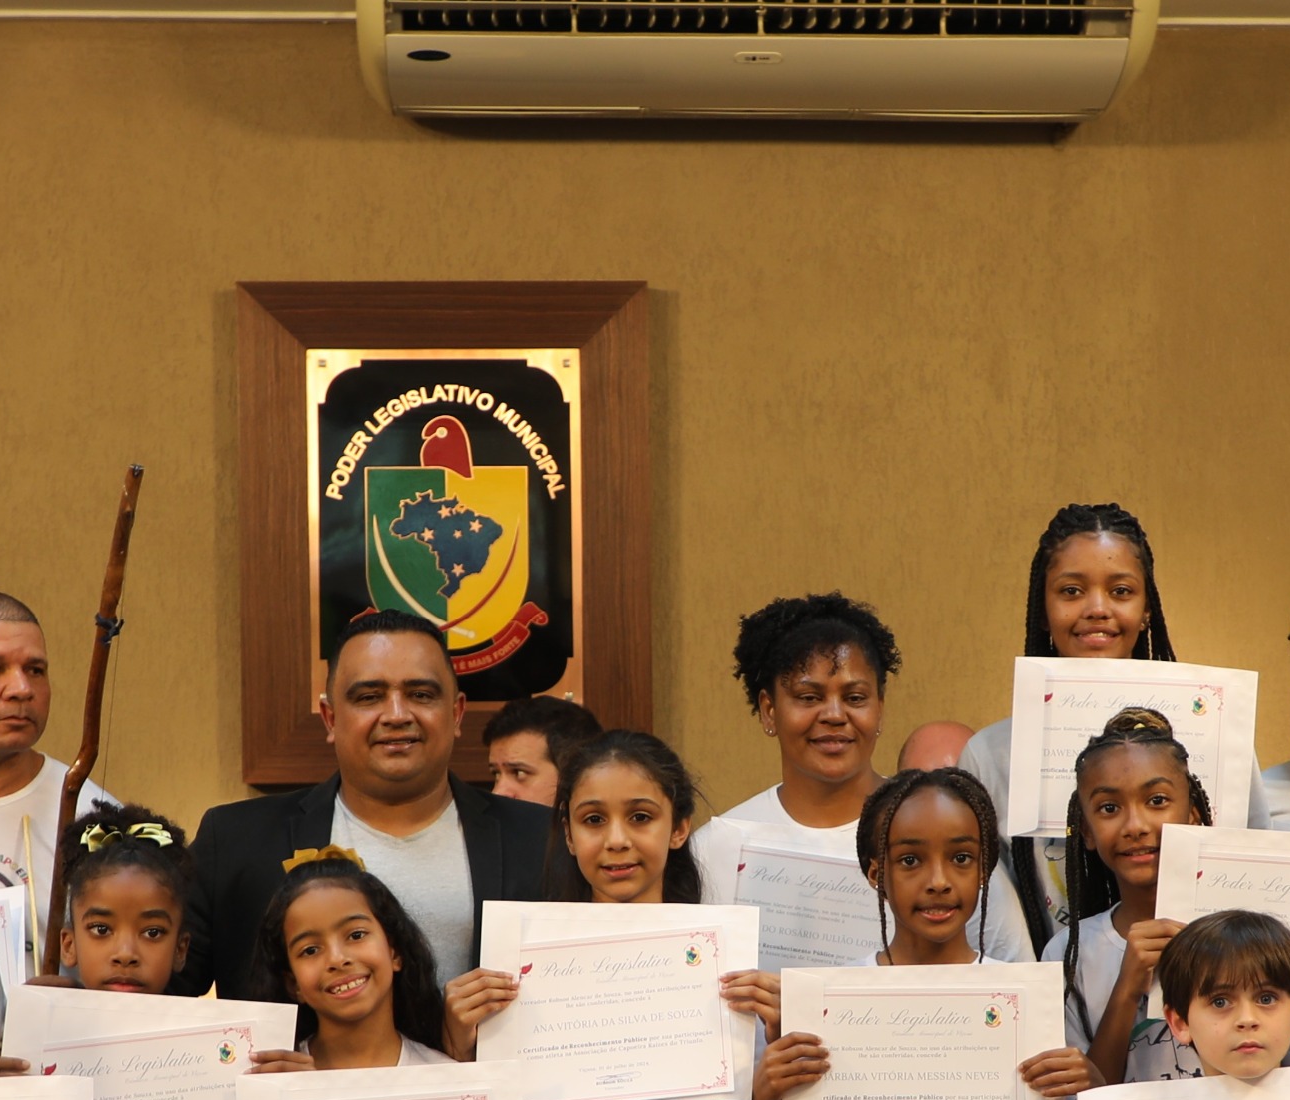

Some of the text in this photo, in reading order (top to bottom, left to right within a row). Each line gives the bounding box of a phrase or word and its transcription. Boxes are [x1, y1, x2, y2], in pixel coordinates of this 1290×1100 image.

[325, 384, 566, 500] PODER LEGISLATIVO MUNICIPAL
[468, 655, 492, 668] MAIS
[1206, 872, 1254, 891] Poder
[539, 959, 584, 979] Poder
[590, 951, 674, 980] Legislativo
[533, 1008, 703, 1034] ANA VITÓRIA DA SILVA DE SOUZA
[834, 1007, 972, 1033] Poder Legislativo
[870, 1069, 915, 1081] VITÓRIA
[917, 1071, 962, 1081] MESSIAS
[965, 1071, 1000, 1081] NEVES
